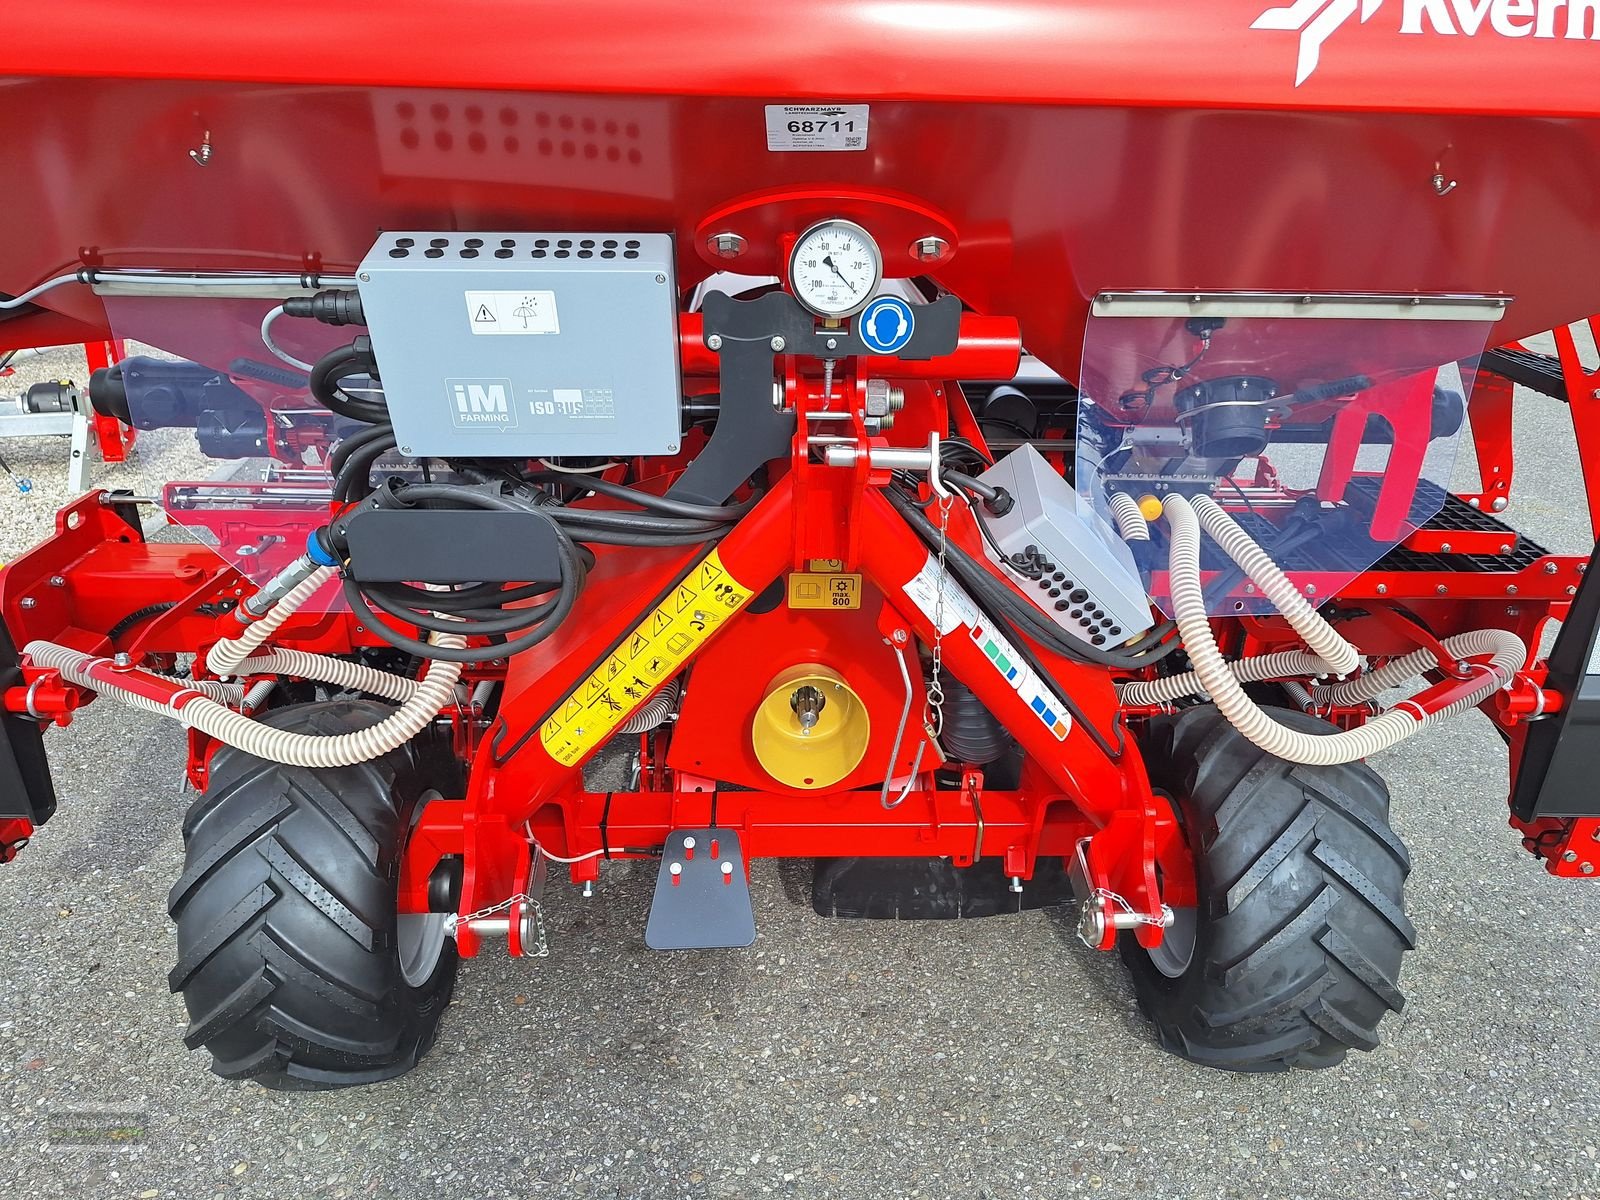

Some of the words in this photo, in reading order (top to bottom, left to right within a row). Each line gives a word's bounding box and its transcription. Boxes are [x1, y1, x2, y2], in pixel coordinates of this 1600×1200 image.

[787, 121, 854, 133] 68711
[817, 242, 830, 251] -60
[838, 243, 851, 251] -40
[804, 260, 817, 268] -80
[850, 261, 862, 270] -20
[808, 280, 823, 288] -100
[454, 384, 508, 413] iM
[529, 401, 583, 415] ISOBUS
[460, 414, 509, 422] FARMING
[832, 598, 850, 606] 800
